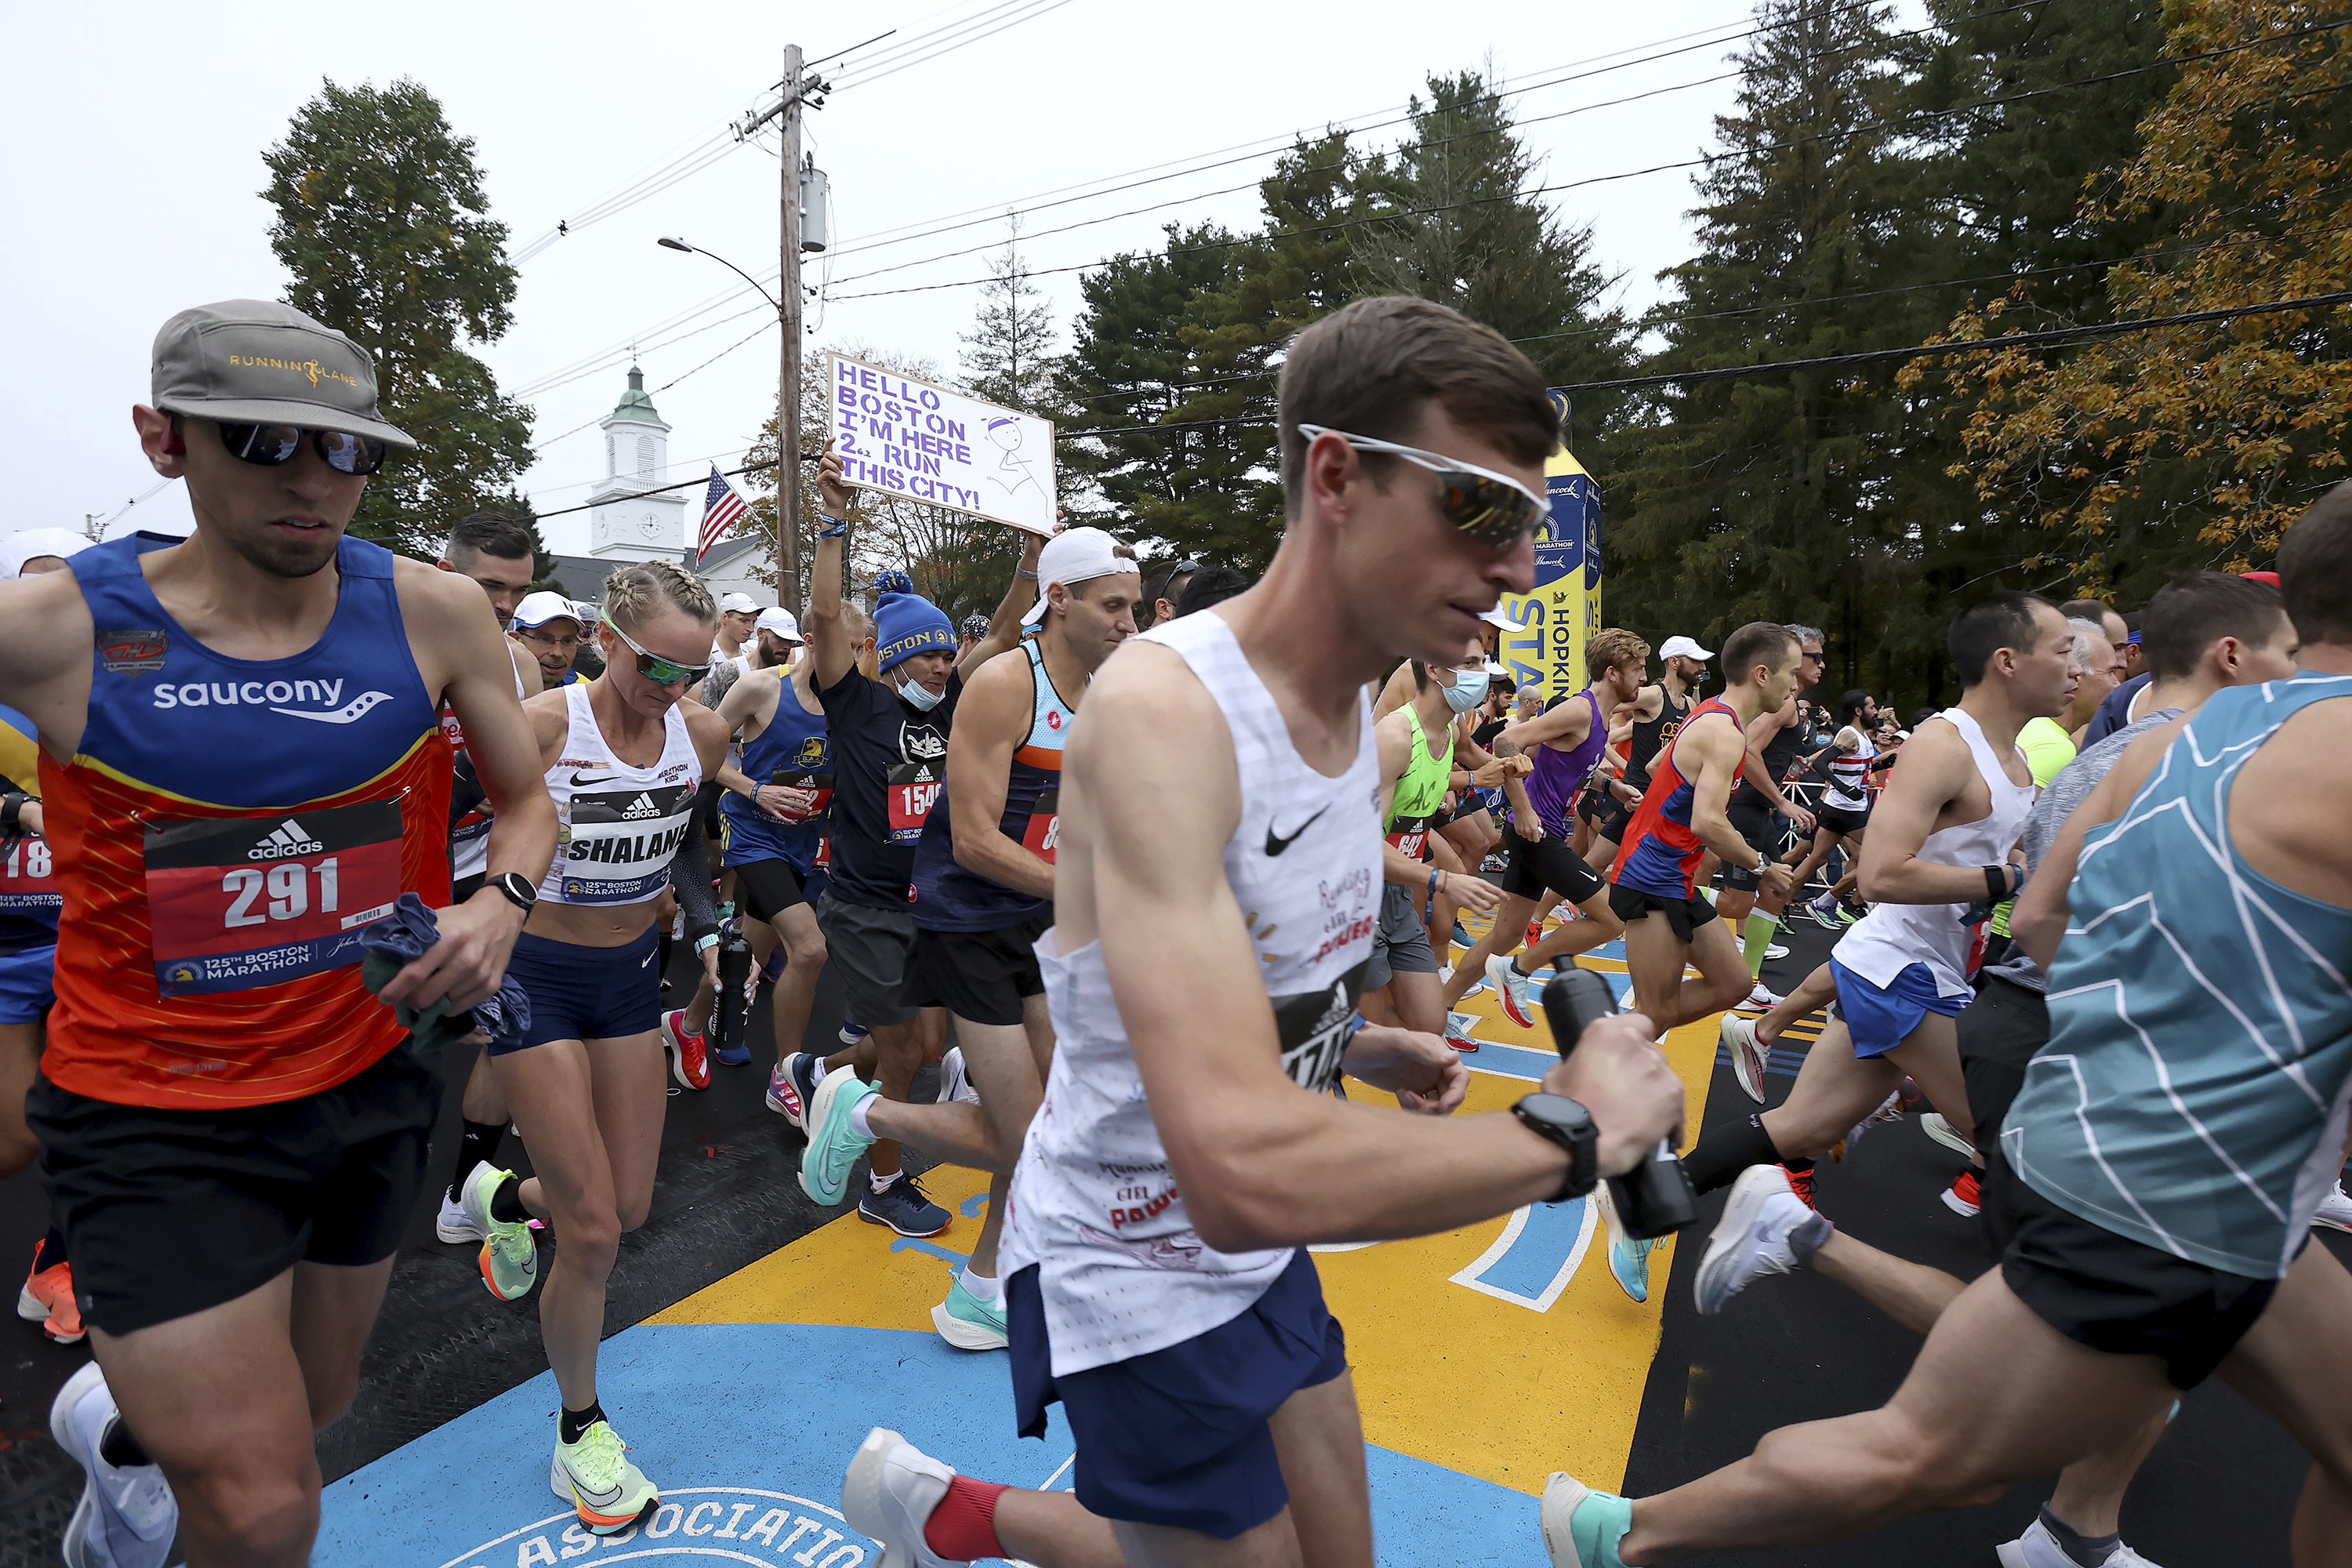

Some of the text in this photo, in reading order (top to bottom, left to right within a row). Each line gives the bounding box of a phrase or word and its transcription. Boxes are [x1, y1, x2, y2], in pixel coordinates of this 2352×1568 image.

[838, 361, 940, 410] HELLO
[838, 385, 965, 441] BOSTON
[838, 408, 971, 465] I'M HERE
[884, 443, 941, 477] RUN
[839, 456, 980, 510] THIS CITY!
[154, 678, 343, 708] saucony
[665, 774, 679, 784] KIDS
[622, 808, 661, 819] adidas
[902, 783, 941, 815] 154
[1042, 816, 1058, 850] 8
[1398, 834, 1424, 857] 642
[247, 839, 324, 860] adidas
[222, 857, 339, 928] 291
[608, 880, 642, 888] BOSTON
[204, 945, 309, 970] 125TH BOSTON
[206, 953, 311, 980] MARATHON
